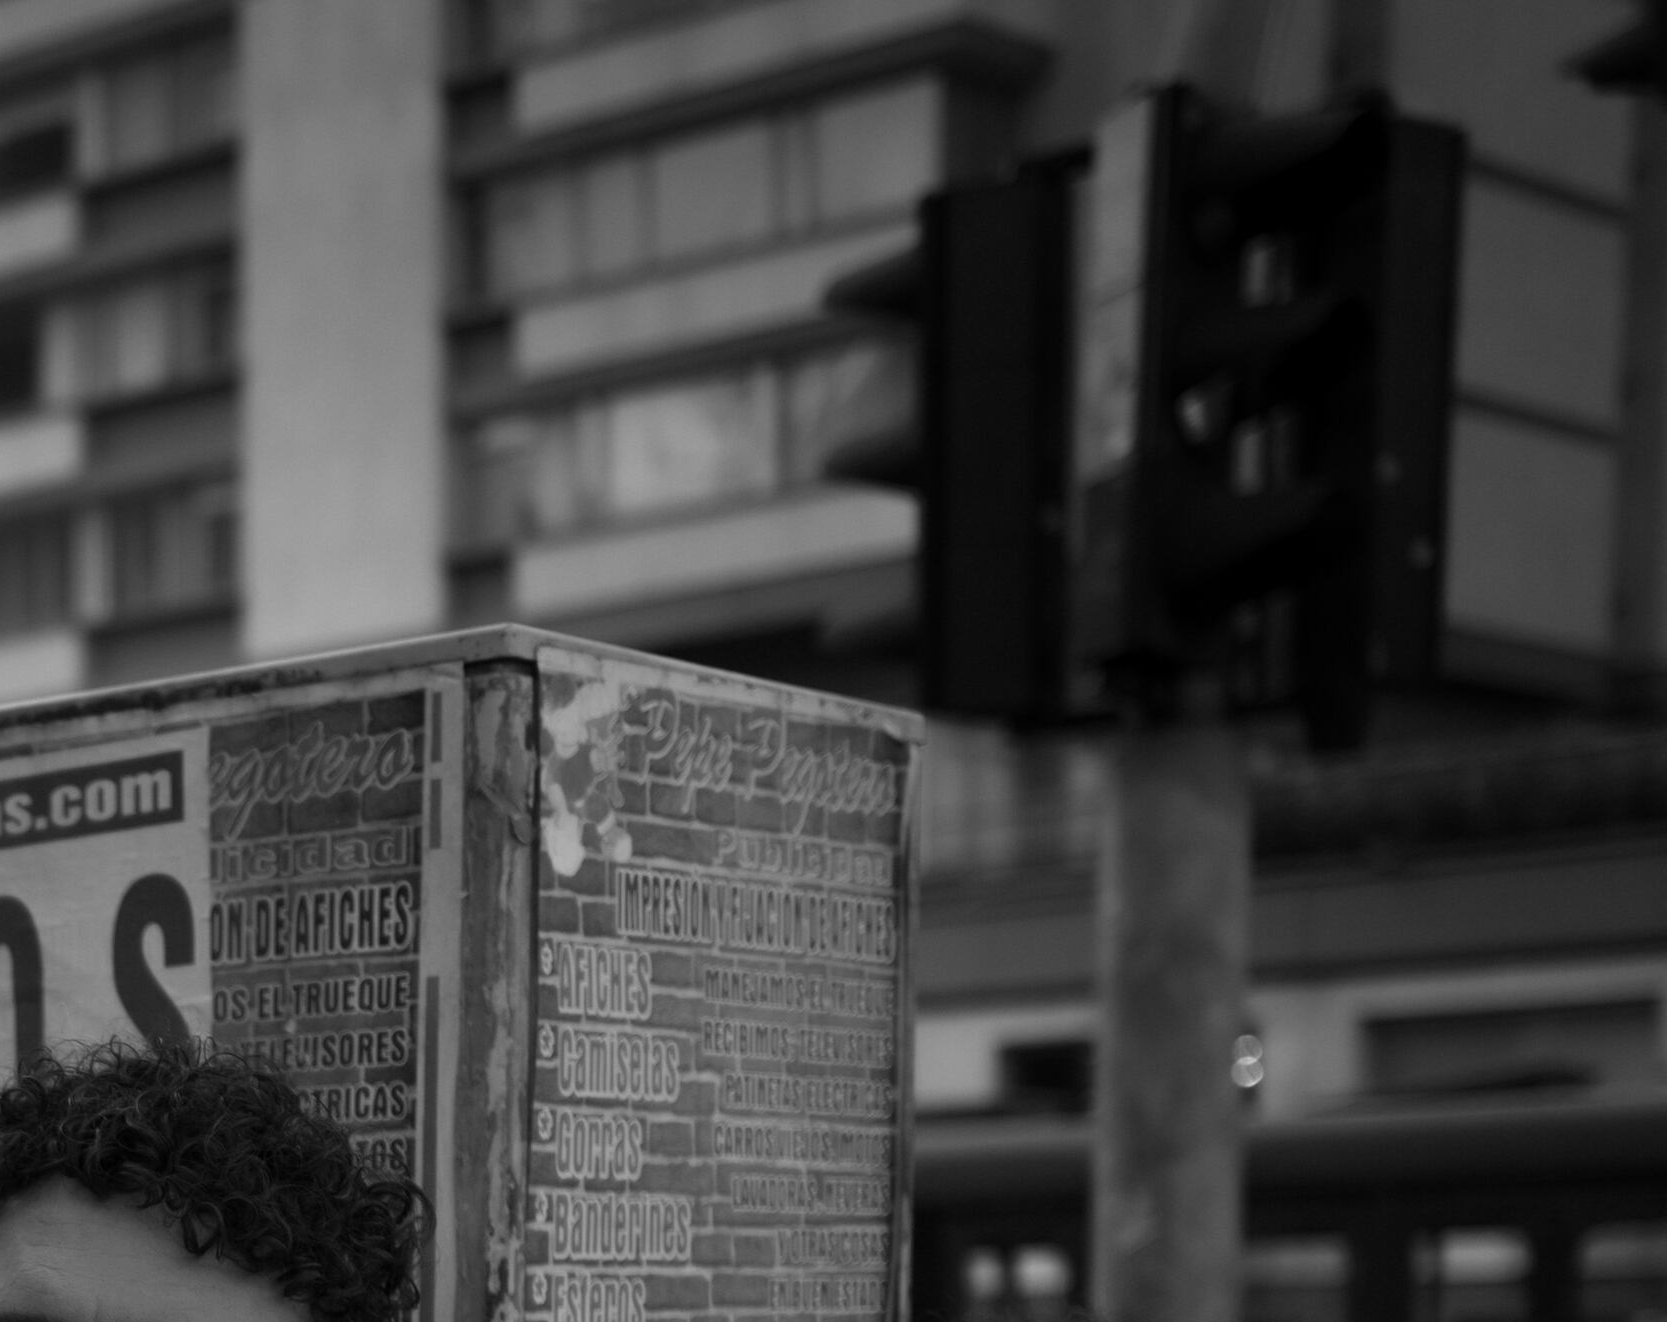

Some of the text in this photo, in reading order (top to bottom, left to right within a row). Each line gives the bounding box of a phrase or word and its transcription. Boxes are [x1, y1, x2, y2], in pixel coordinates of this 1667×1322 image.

[254, 895, 288, 960] DE
[295, 881, 412, 957] AFICHES
[258, 982, 284, 1021] EL
[292, 972, 411, 1017] TRUEQUE
[559, 944, 651, 1020] AFICHES
[559, 1025, 680, 1103] Camisetas
[556, 1107, 643, 1182] Gorras
[553, 1193, 691, 1260] Banderines
